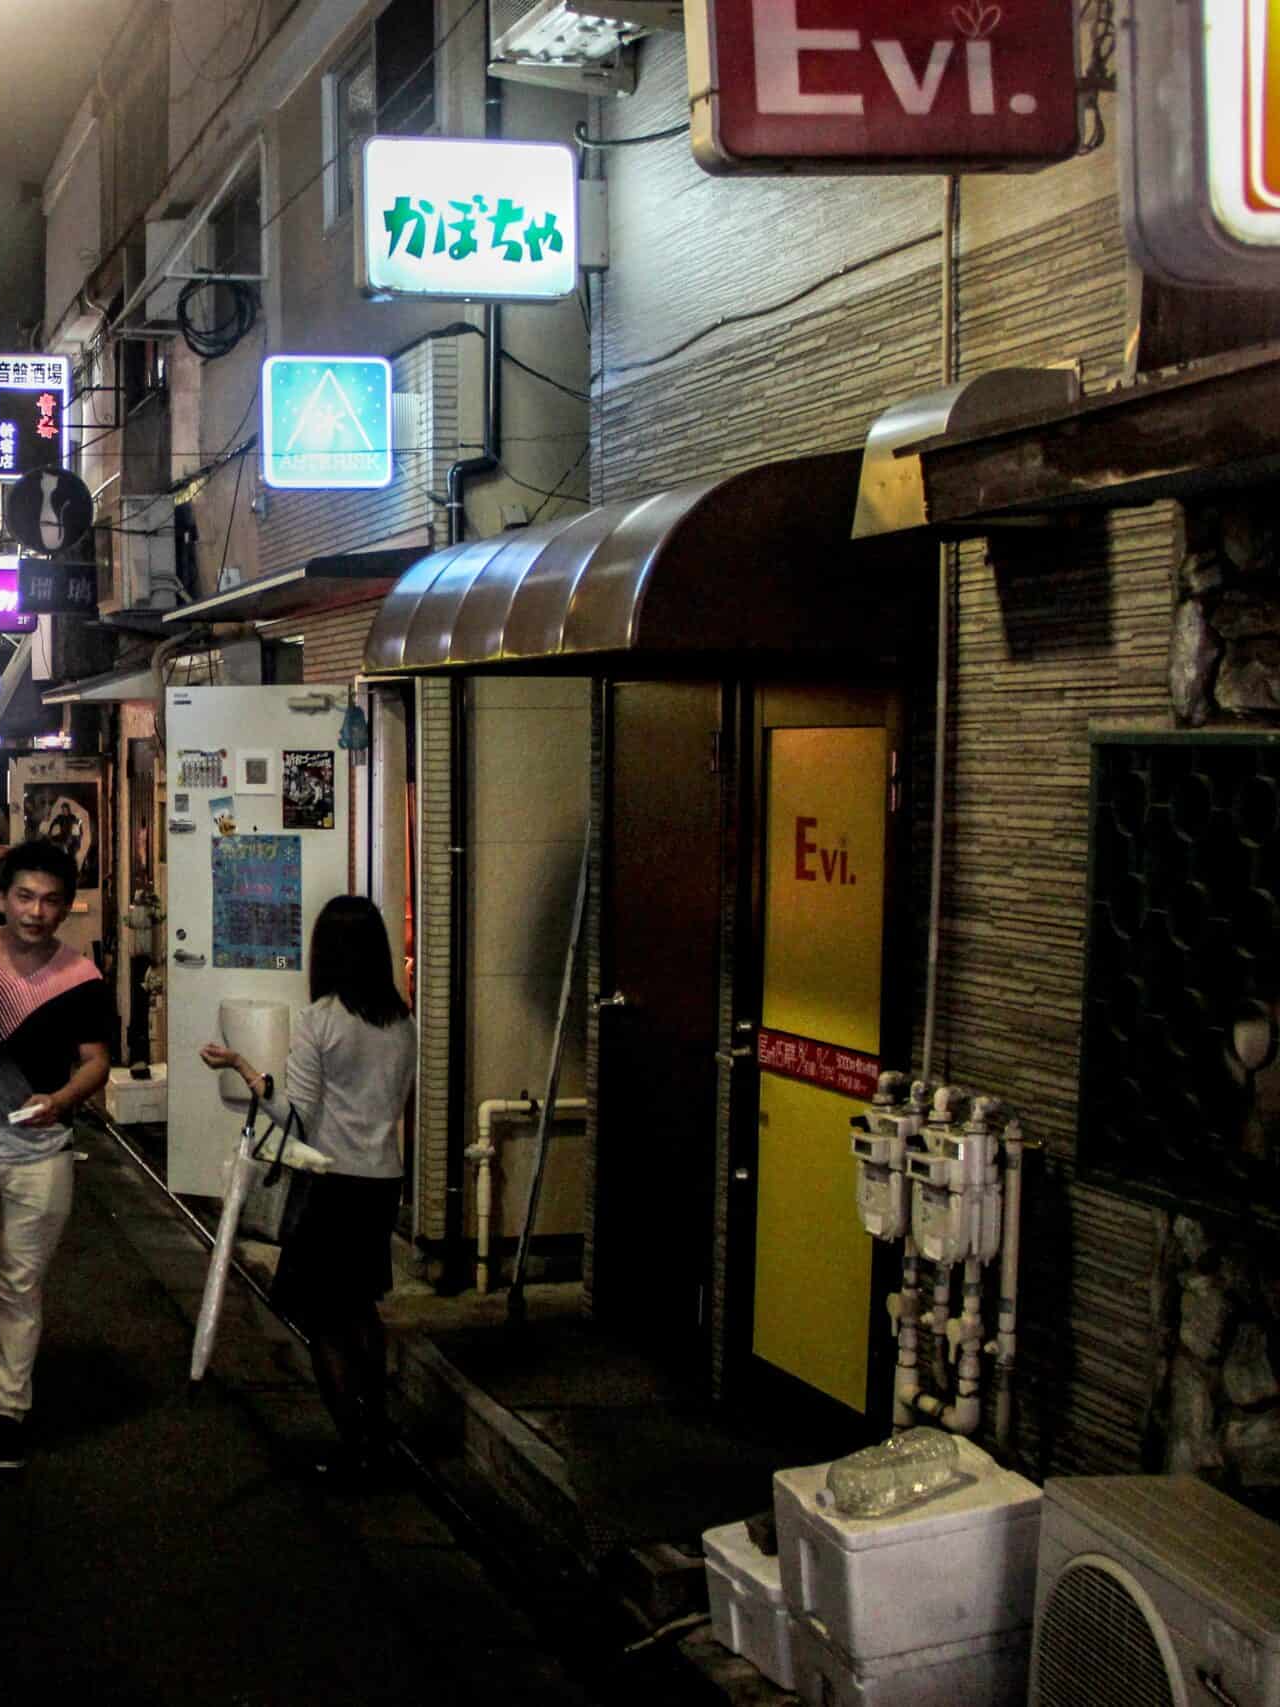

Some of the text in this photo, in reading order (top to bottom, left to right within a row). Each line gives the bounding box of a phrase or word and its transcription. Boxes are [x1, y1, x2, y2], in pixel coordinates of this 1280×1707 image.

[751, 0, 1038, 115] Evi.
[382, 194, 564, 263] かぼちゃ
[794, 815, 857, 886] Evi.
